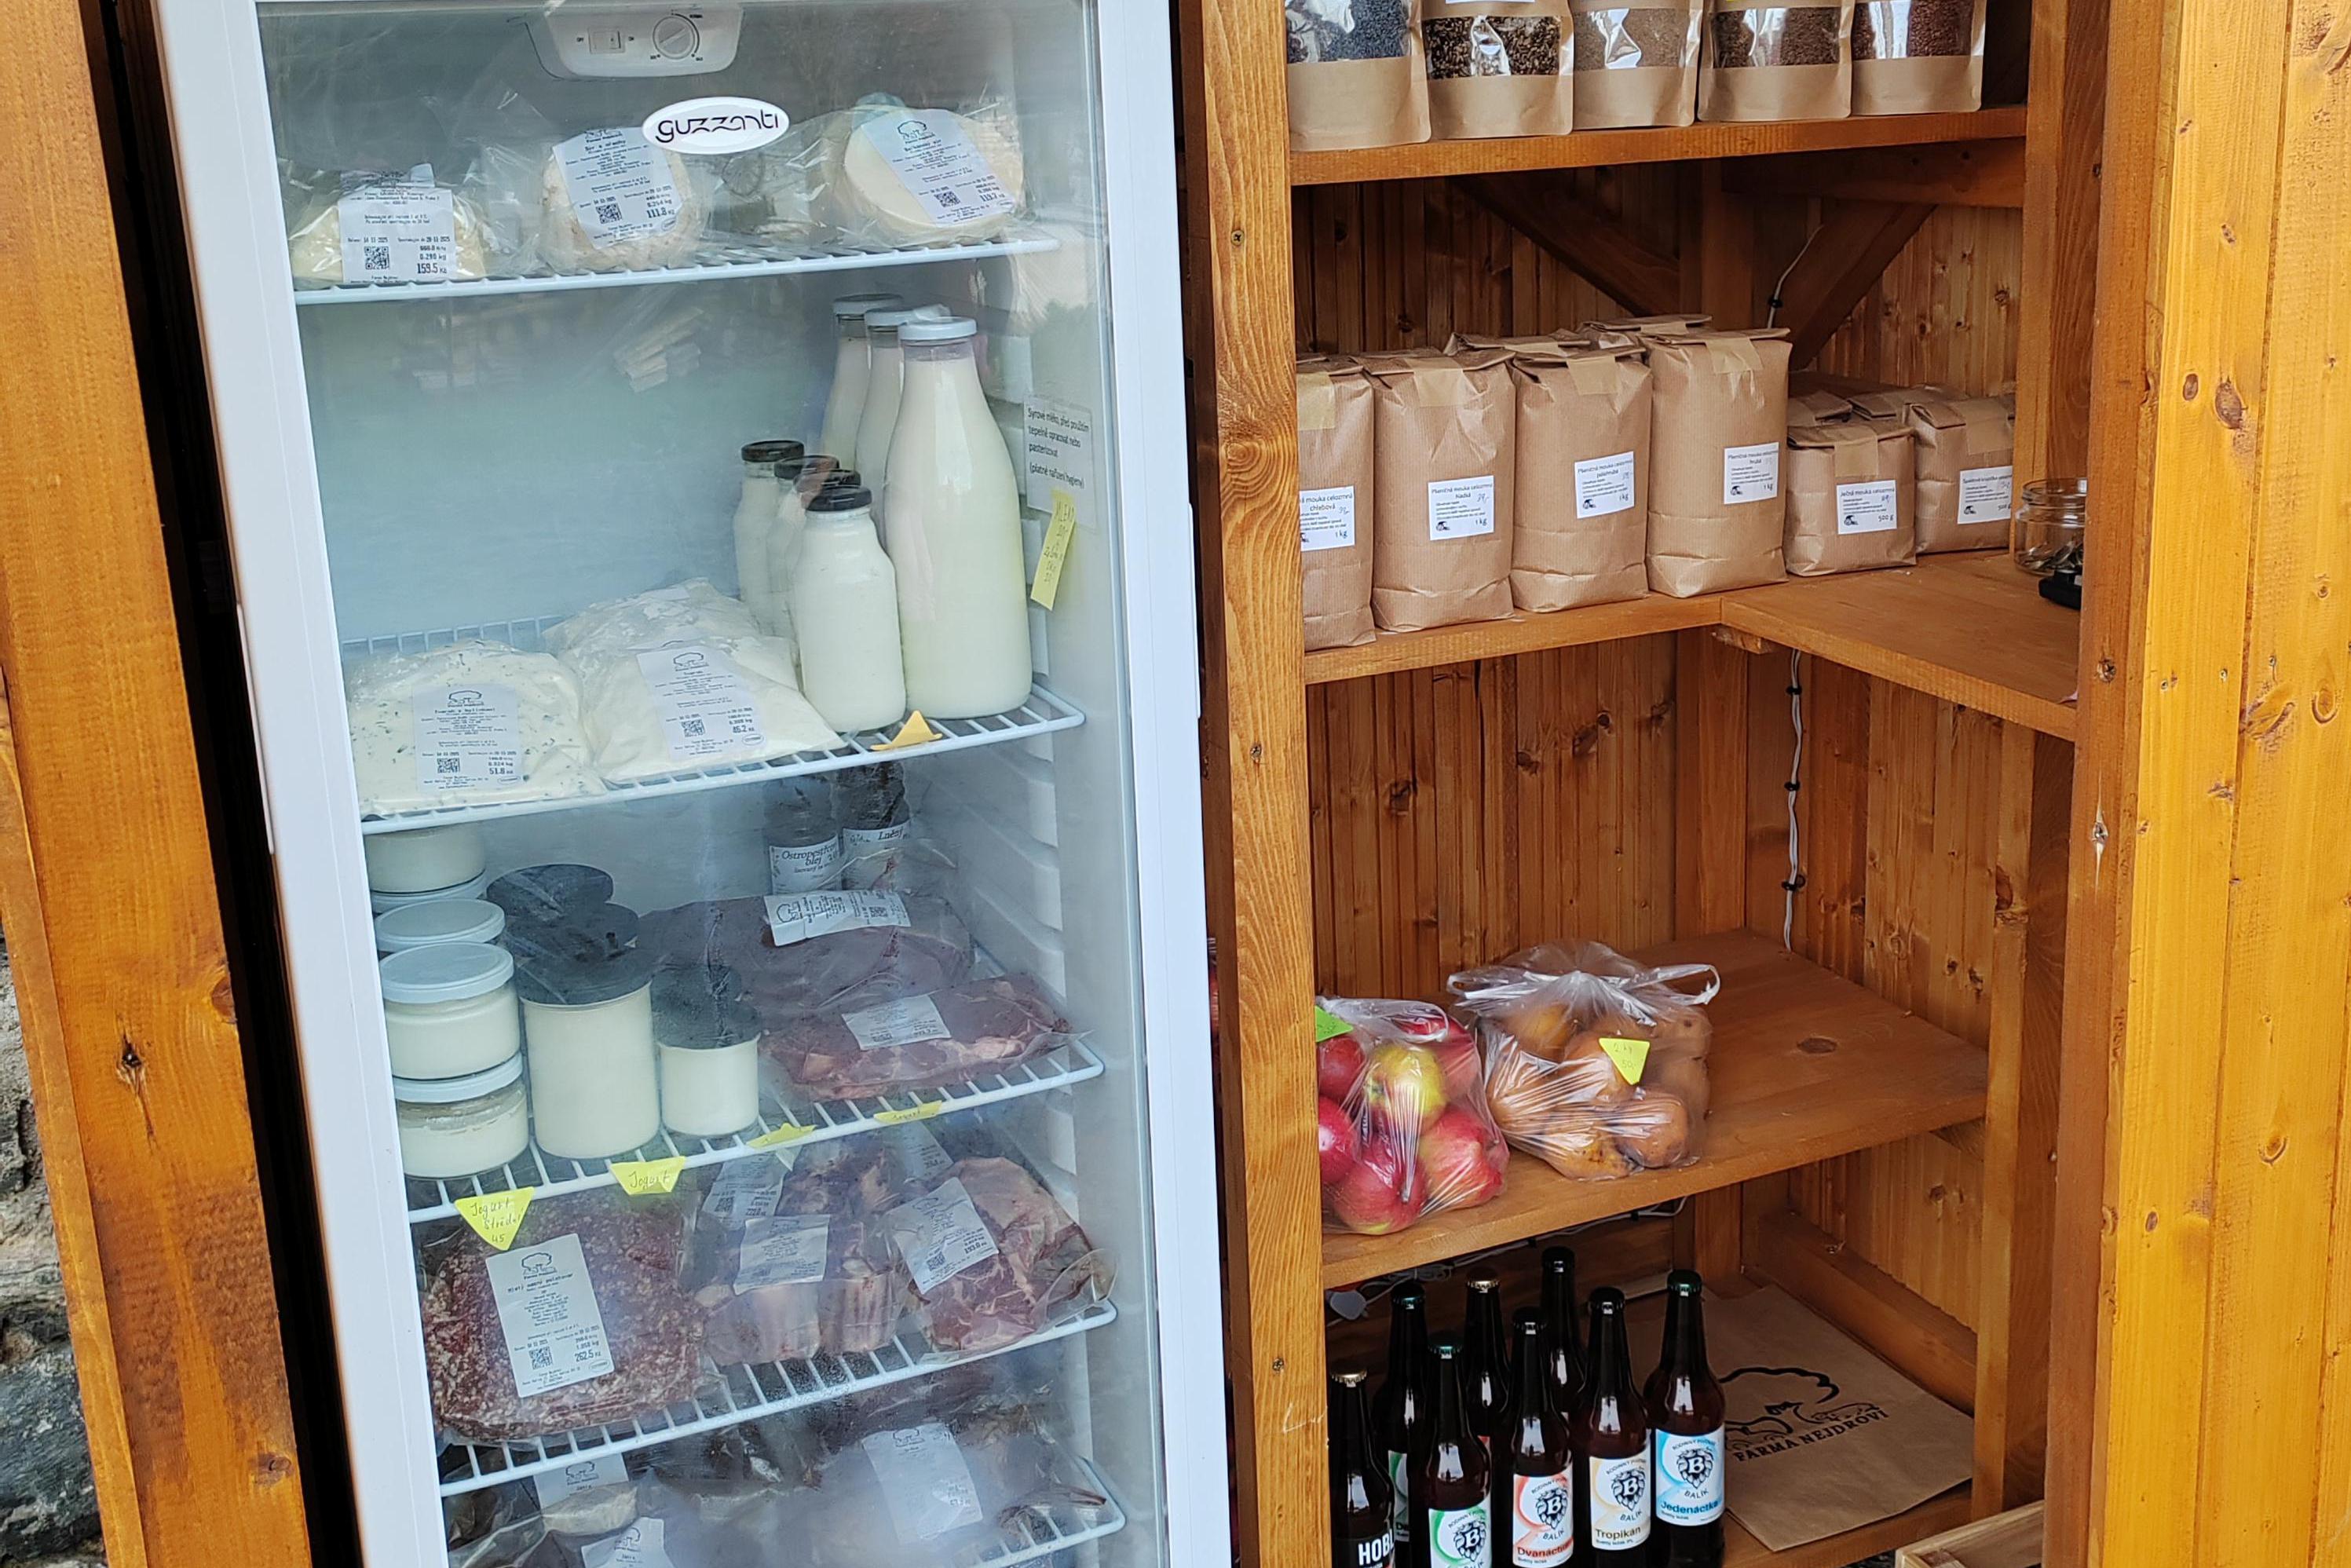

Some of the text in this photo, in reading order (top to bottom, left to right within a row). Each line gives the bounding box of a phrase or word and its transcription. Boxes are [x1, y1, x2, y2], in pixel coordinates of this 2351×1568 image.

[655, 109, 779, 144] guzzanti
[417, 263, 438, 274] 159.5
[629, 1171, 670, 1190] Jogurt
[470, 1197, 510, 1219] Jogurt
[1733, 1409, 1889, 1461] FARMA NEJDROVI
[1660, 1500, 1718, 1514] Jedenáctka
